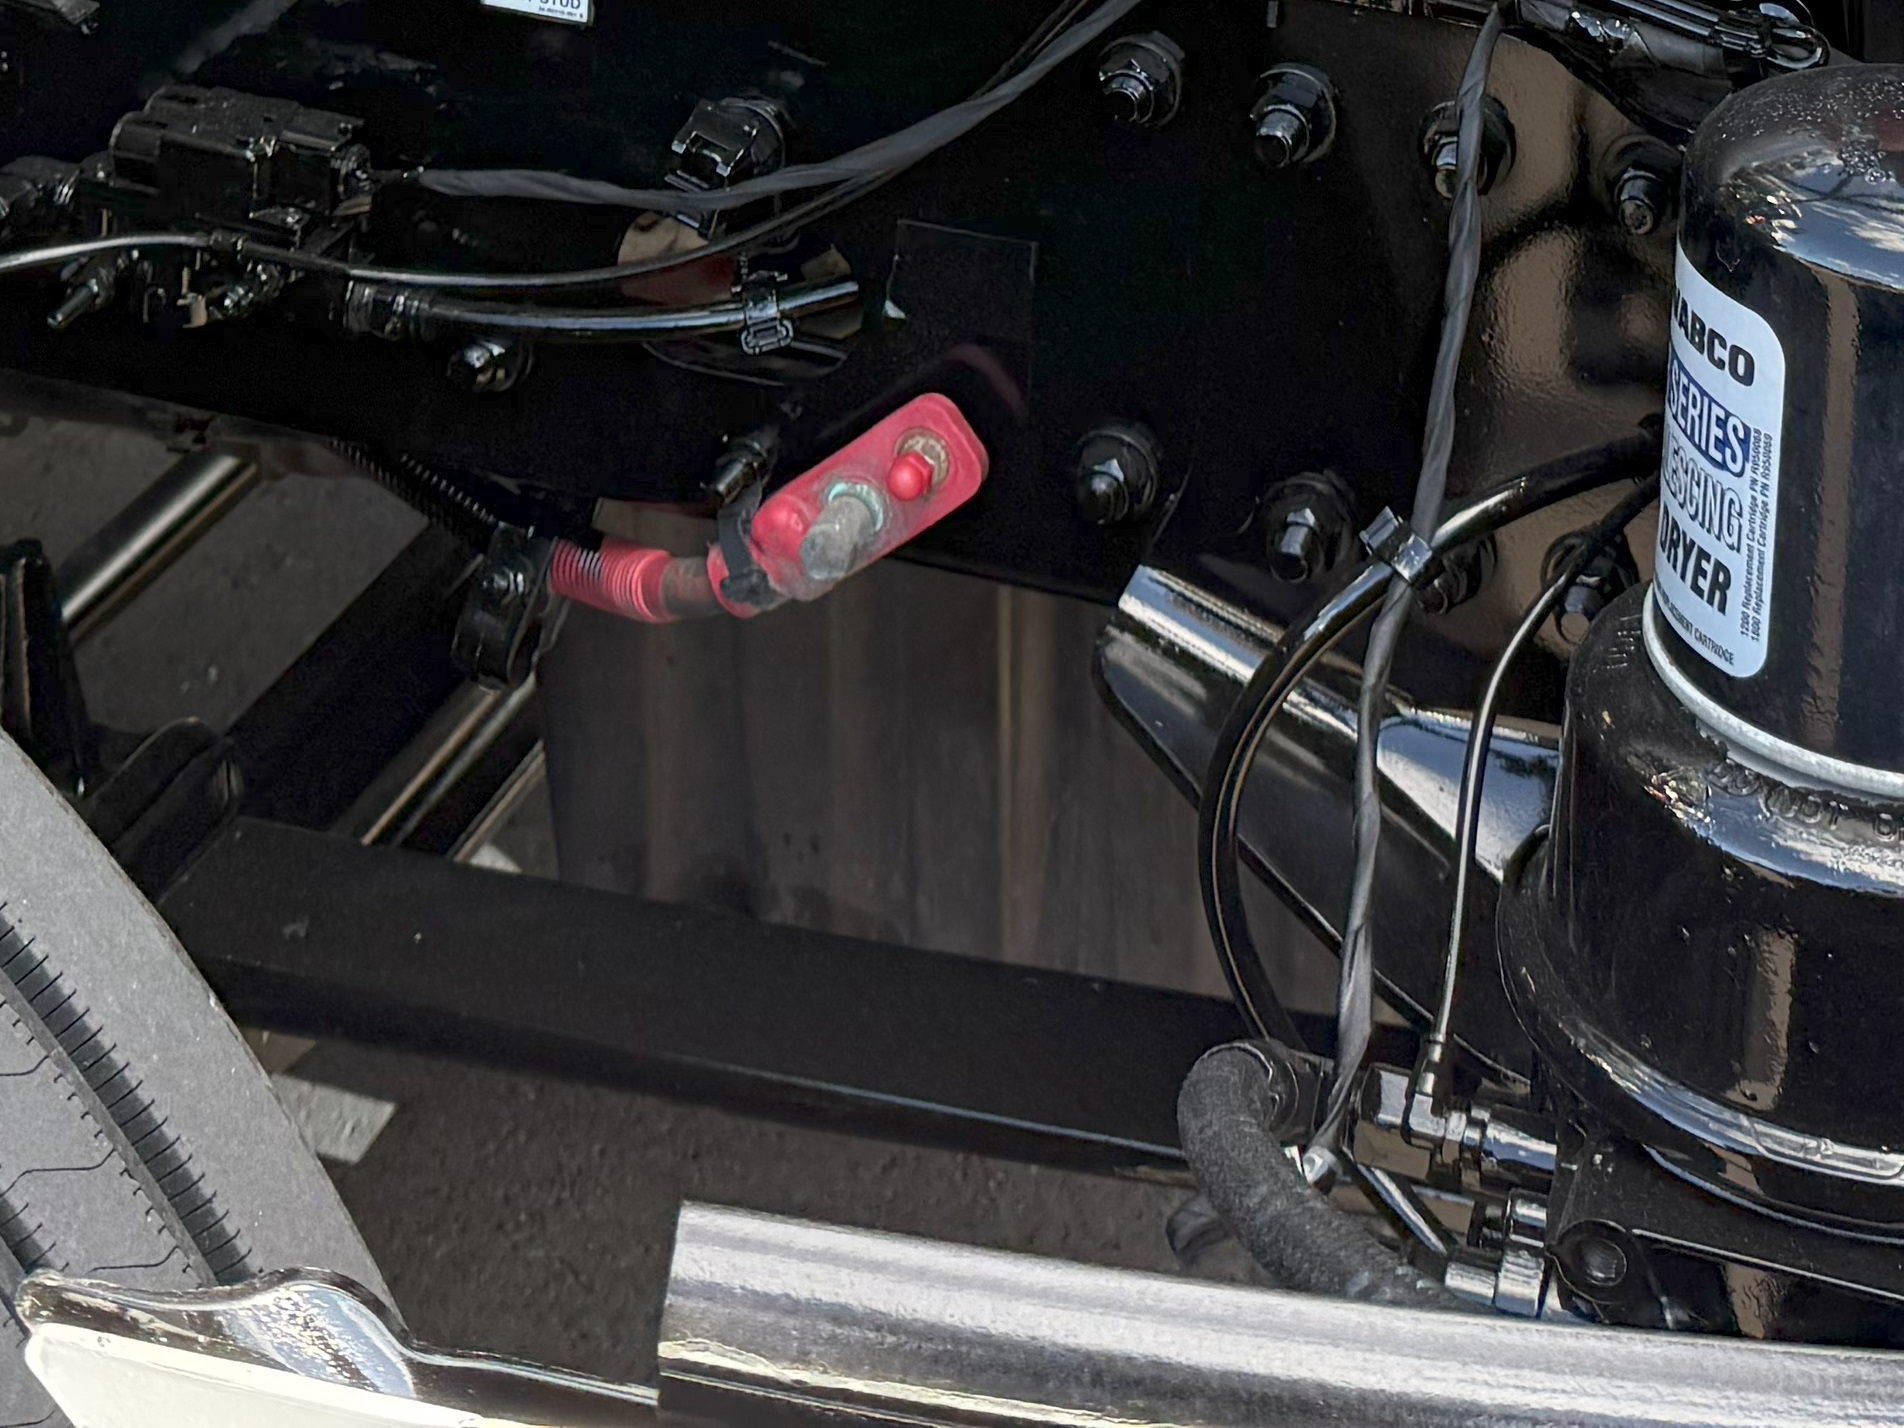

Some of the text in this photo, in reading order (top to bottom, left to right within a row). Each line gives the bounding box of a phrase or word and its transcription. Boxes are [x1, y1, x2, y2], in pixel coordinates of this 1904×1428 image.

[1669, 358, 1745, 475] SERIES
[1749, 476, 1759, 494] PN
[1760, 482, 1770, 499] PN
[1746, 494, 1760, 543] Cartridge
[1756, 500, 1771, 550] Cartridge
[1659, 503, 1731, 617] DRYER
[1742, 544, 1756, 612] Replacement
[1752, 552, 1766, 616] Replacement
[1694, 625, 1735, 666] CARTRIDGE
